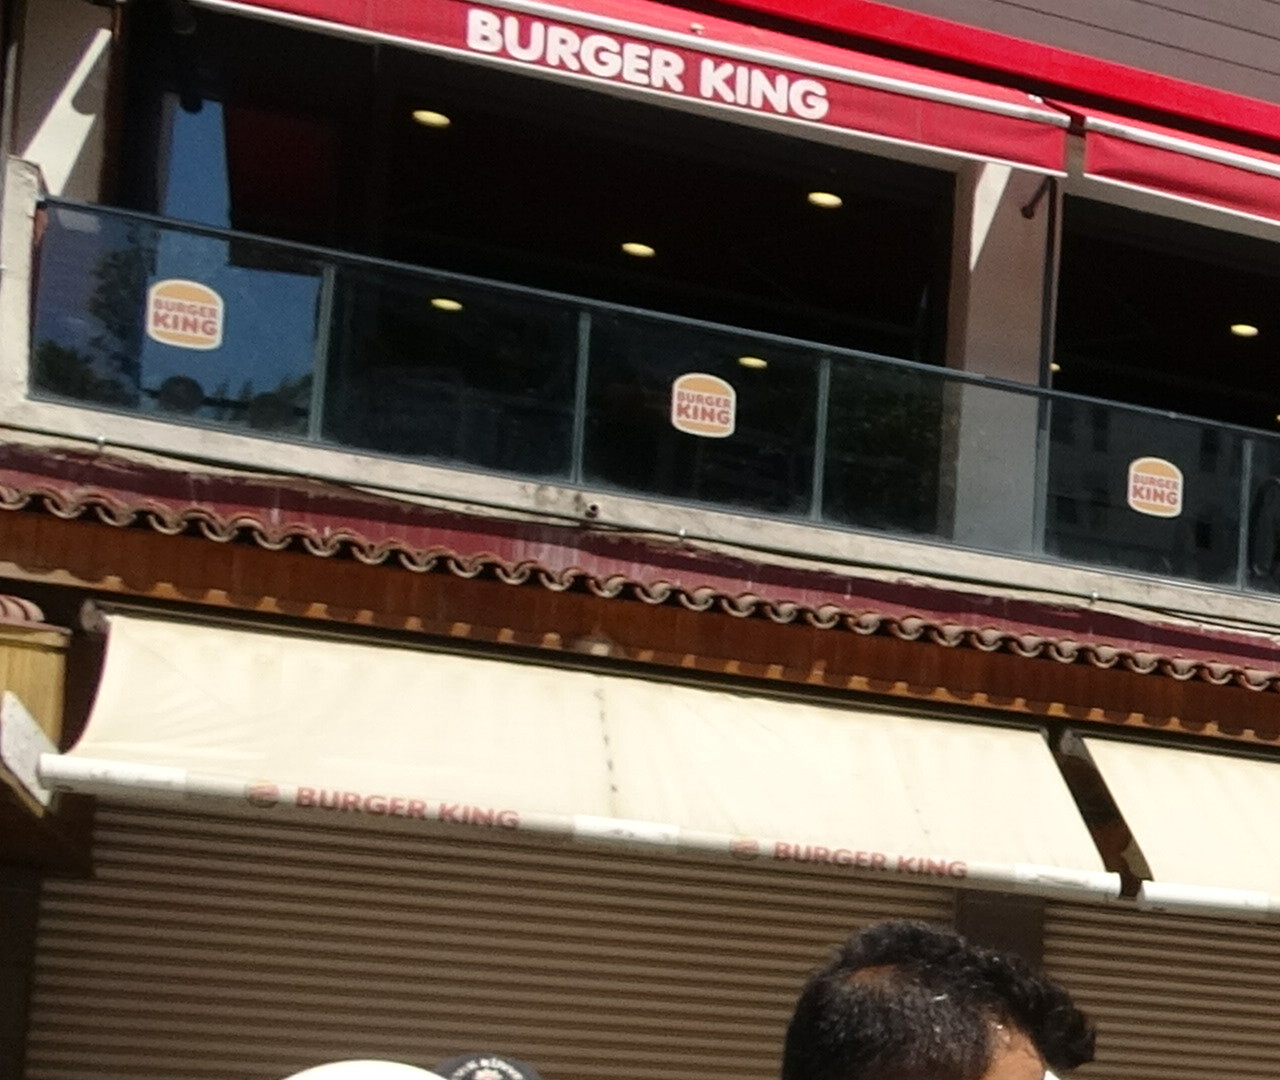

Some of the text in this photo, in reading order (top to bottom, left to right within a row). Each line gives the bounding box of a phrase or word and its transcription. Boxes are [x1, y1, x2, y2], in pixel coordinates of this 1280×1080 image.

[466, 9, 830, 121] BURGER KING
[153, 298, 217, 318] BURGER
[153, 311, 217, 336] KING
[677, 390, 730, 408] BURGER
[677, 402, 730, 425] KING
[1133, 474, 1178, 490] BURGER
[1133, 484, 1178, 505] KING
[296, 786, 427, 820] BURGER
[438, 803, 520, 829] KING
[773, 842, 887, 871] BURGER
[896, 855, 968, 878] KING
